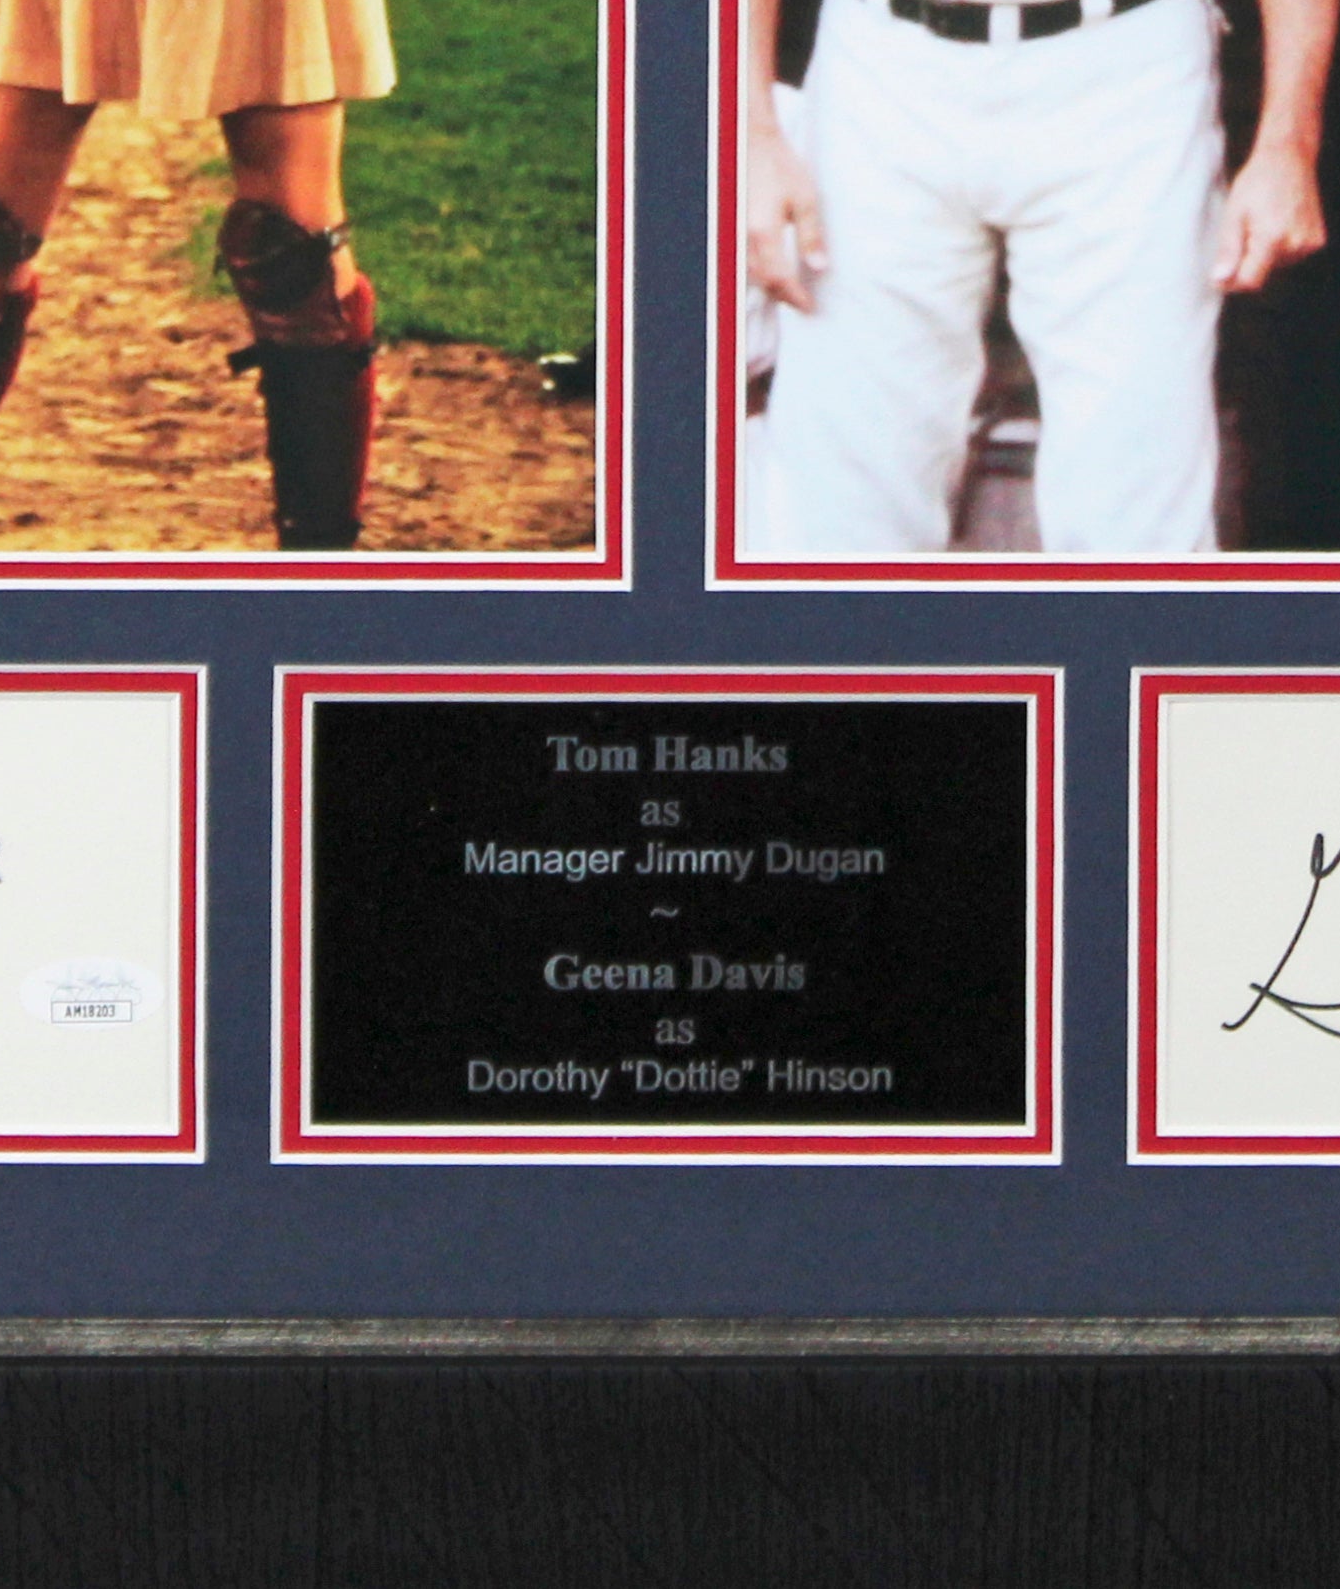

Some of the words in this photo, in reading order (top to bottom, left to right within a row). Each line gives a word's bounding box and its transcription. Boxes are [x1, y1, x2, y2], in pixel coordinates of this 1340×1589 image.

[547, 735, 638, 772] Tom
[654, 735, 788, 772] Hanks
[640, 800, 680, 827] as
[464, 841, 625, 883] Manager
[635, 841, 754, 883] Jimmy
[766, 841, 885, 883] Dugan
[543, 953, 675, 992] Geena
[690, 953, 805, 991] Davis
[655, 1018, 696, 1045] as
[467, 1059, 610, 1100] Dorothy
[621, 1059, 755, 1092] “Dottie”
[767, 1059, 893, 1092] Hinson
